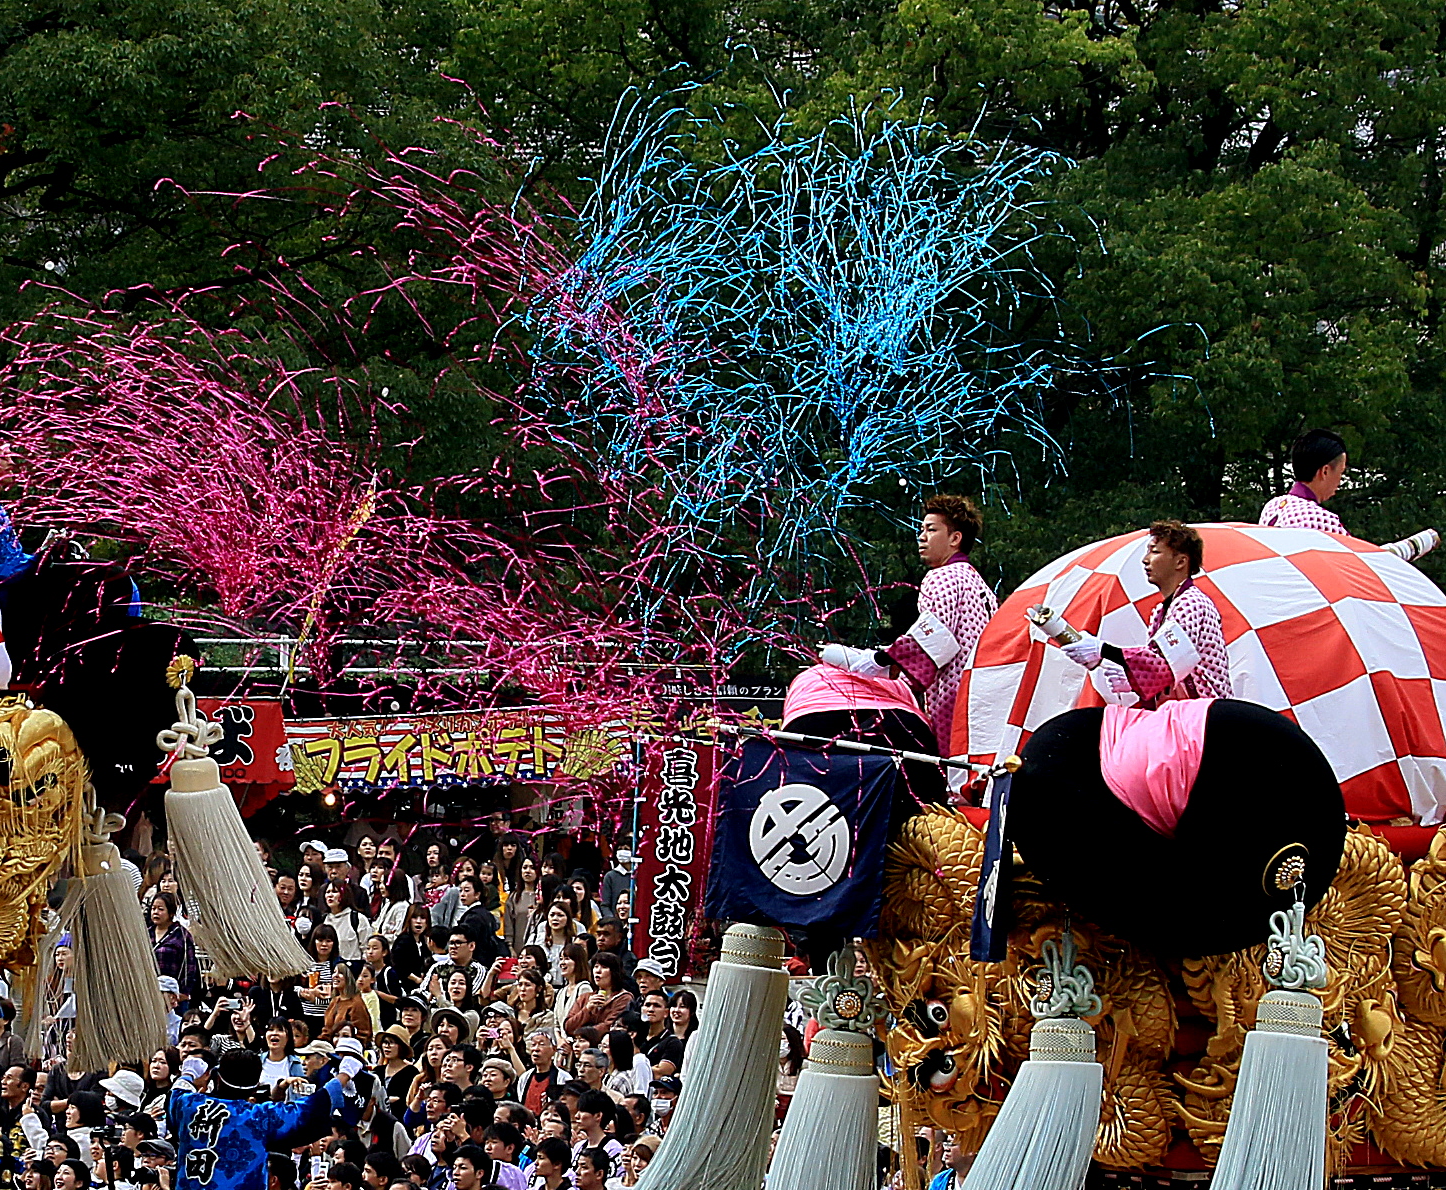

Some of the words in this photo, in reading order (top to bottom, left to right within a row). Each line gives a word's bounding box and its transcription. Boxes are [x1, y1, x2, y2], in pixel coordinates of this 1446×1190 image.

[305, 725, 566, 785] フライドポテト
[186, 1099, 231, 1185] 新田
